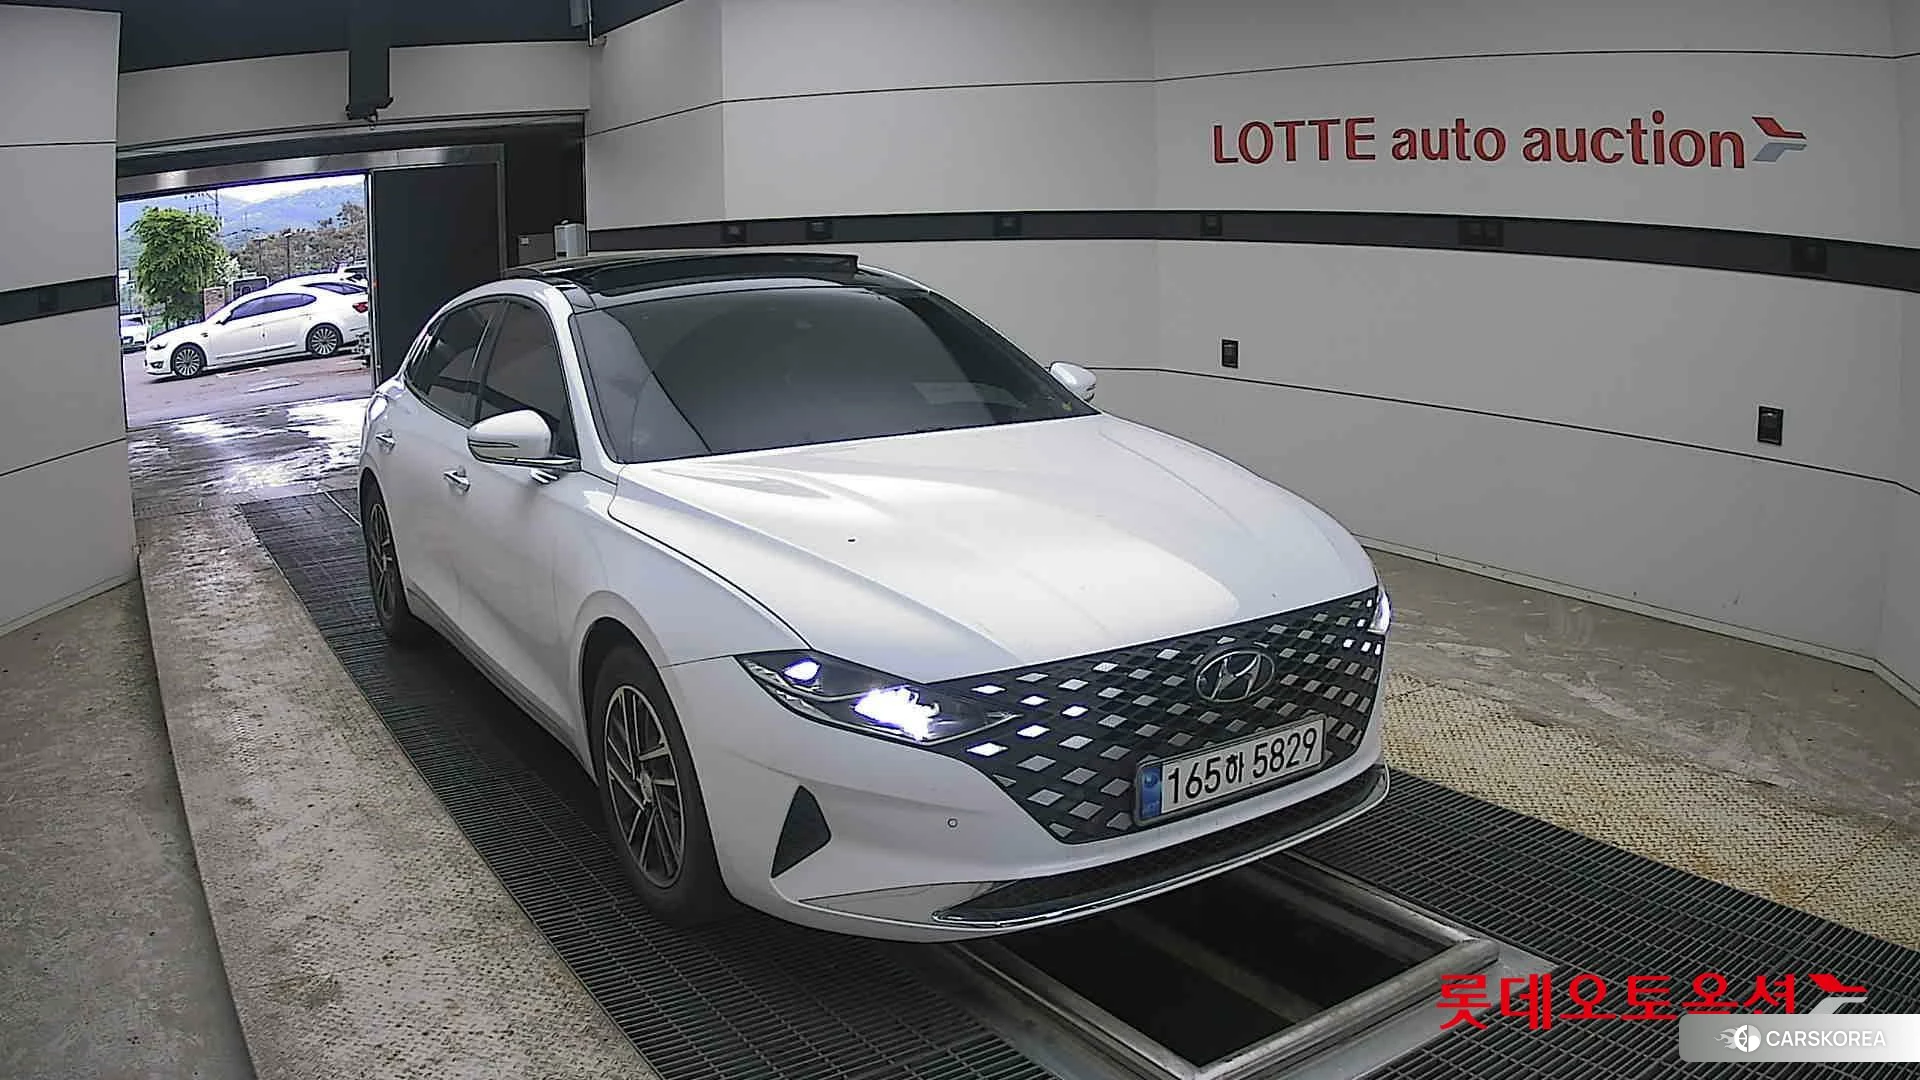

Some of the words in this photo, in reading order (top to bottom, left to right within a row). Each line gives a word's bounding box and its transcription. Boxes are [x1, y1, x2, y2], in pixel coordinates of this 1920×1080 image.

[1213, 117, 1376, 164] LOTTE
[1391, 118, 1506, 162] auto
[1522, 110, 1746, 169] auction
[1168, 751, 1245, 804] 165하
[1252, 727, 1318, 779] 5829
